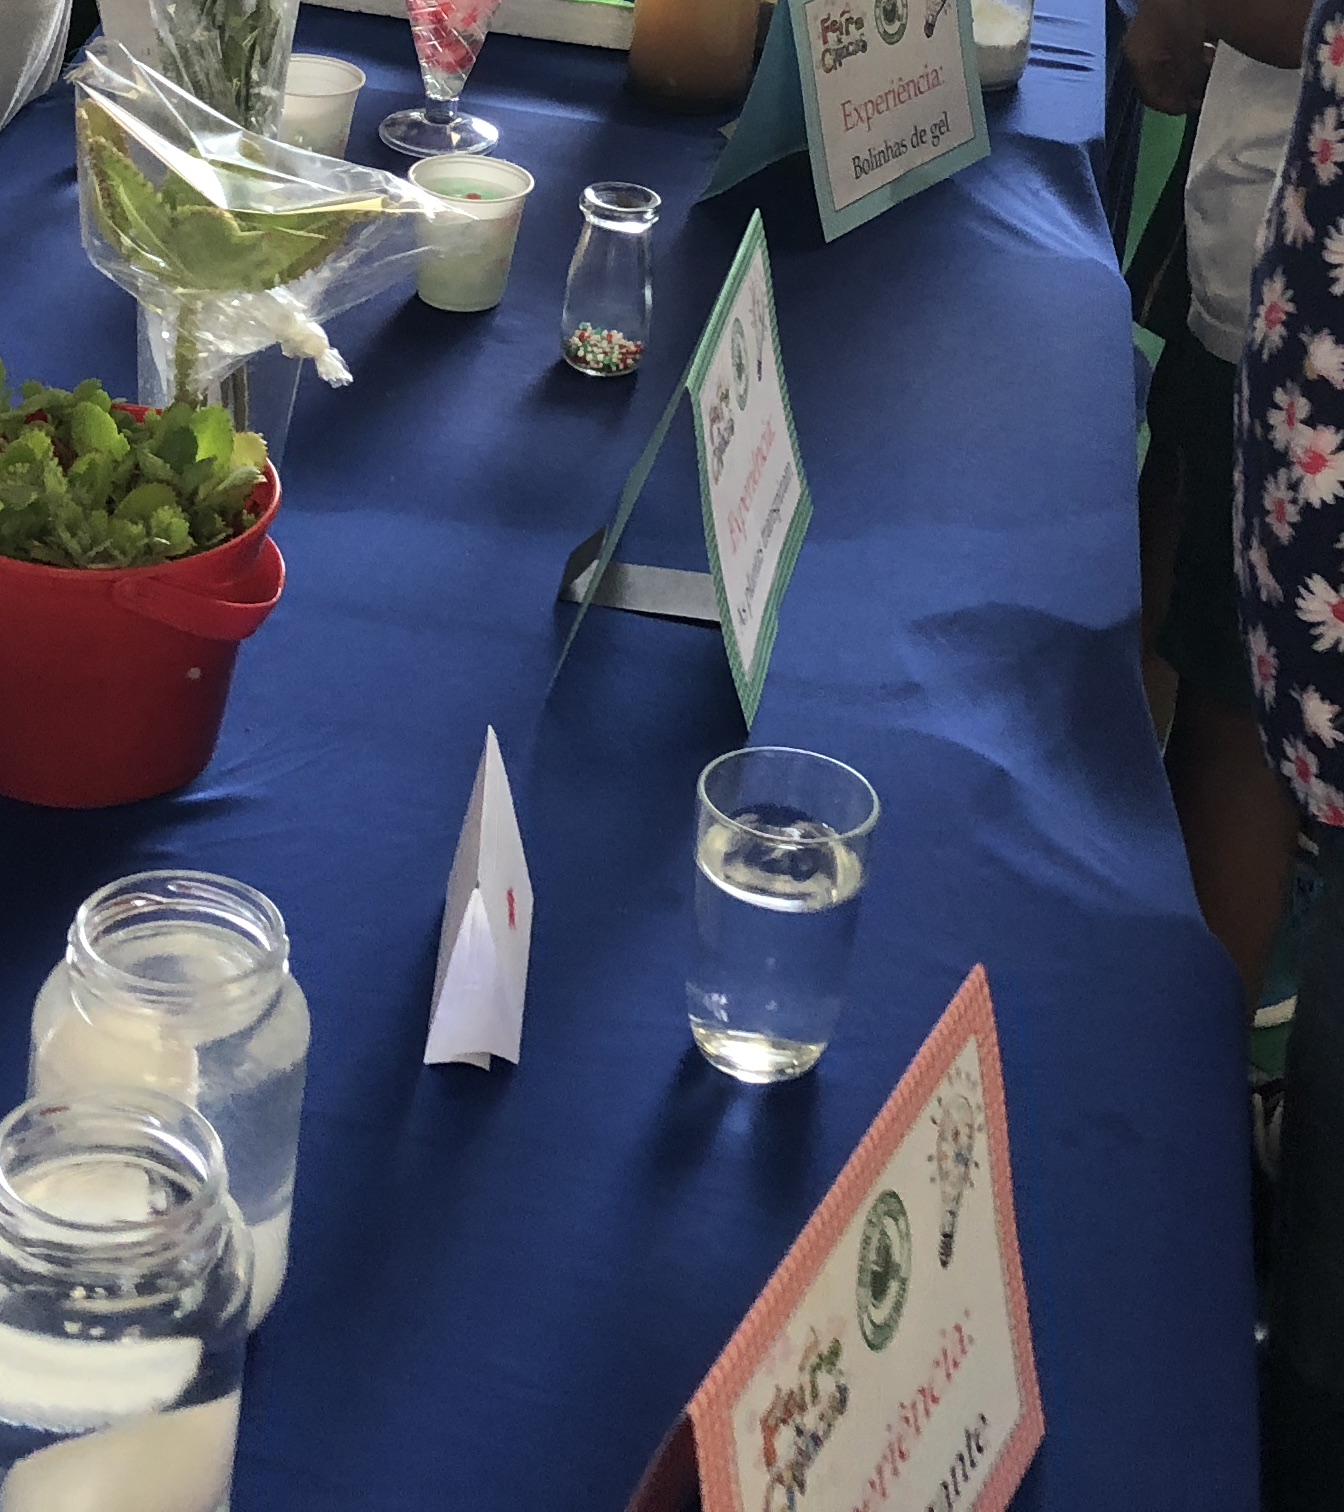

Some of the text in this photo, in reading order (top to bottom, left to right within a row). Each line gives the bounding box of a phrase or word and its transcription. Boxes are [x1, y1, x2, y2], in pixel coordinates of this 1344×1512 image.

[840, 63, 945, 133] Experiência:
[851, 112, 951, 180] Bolinhas de gel
